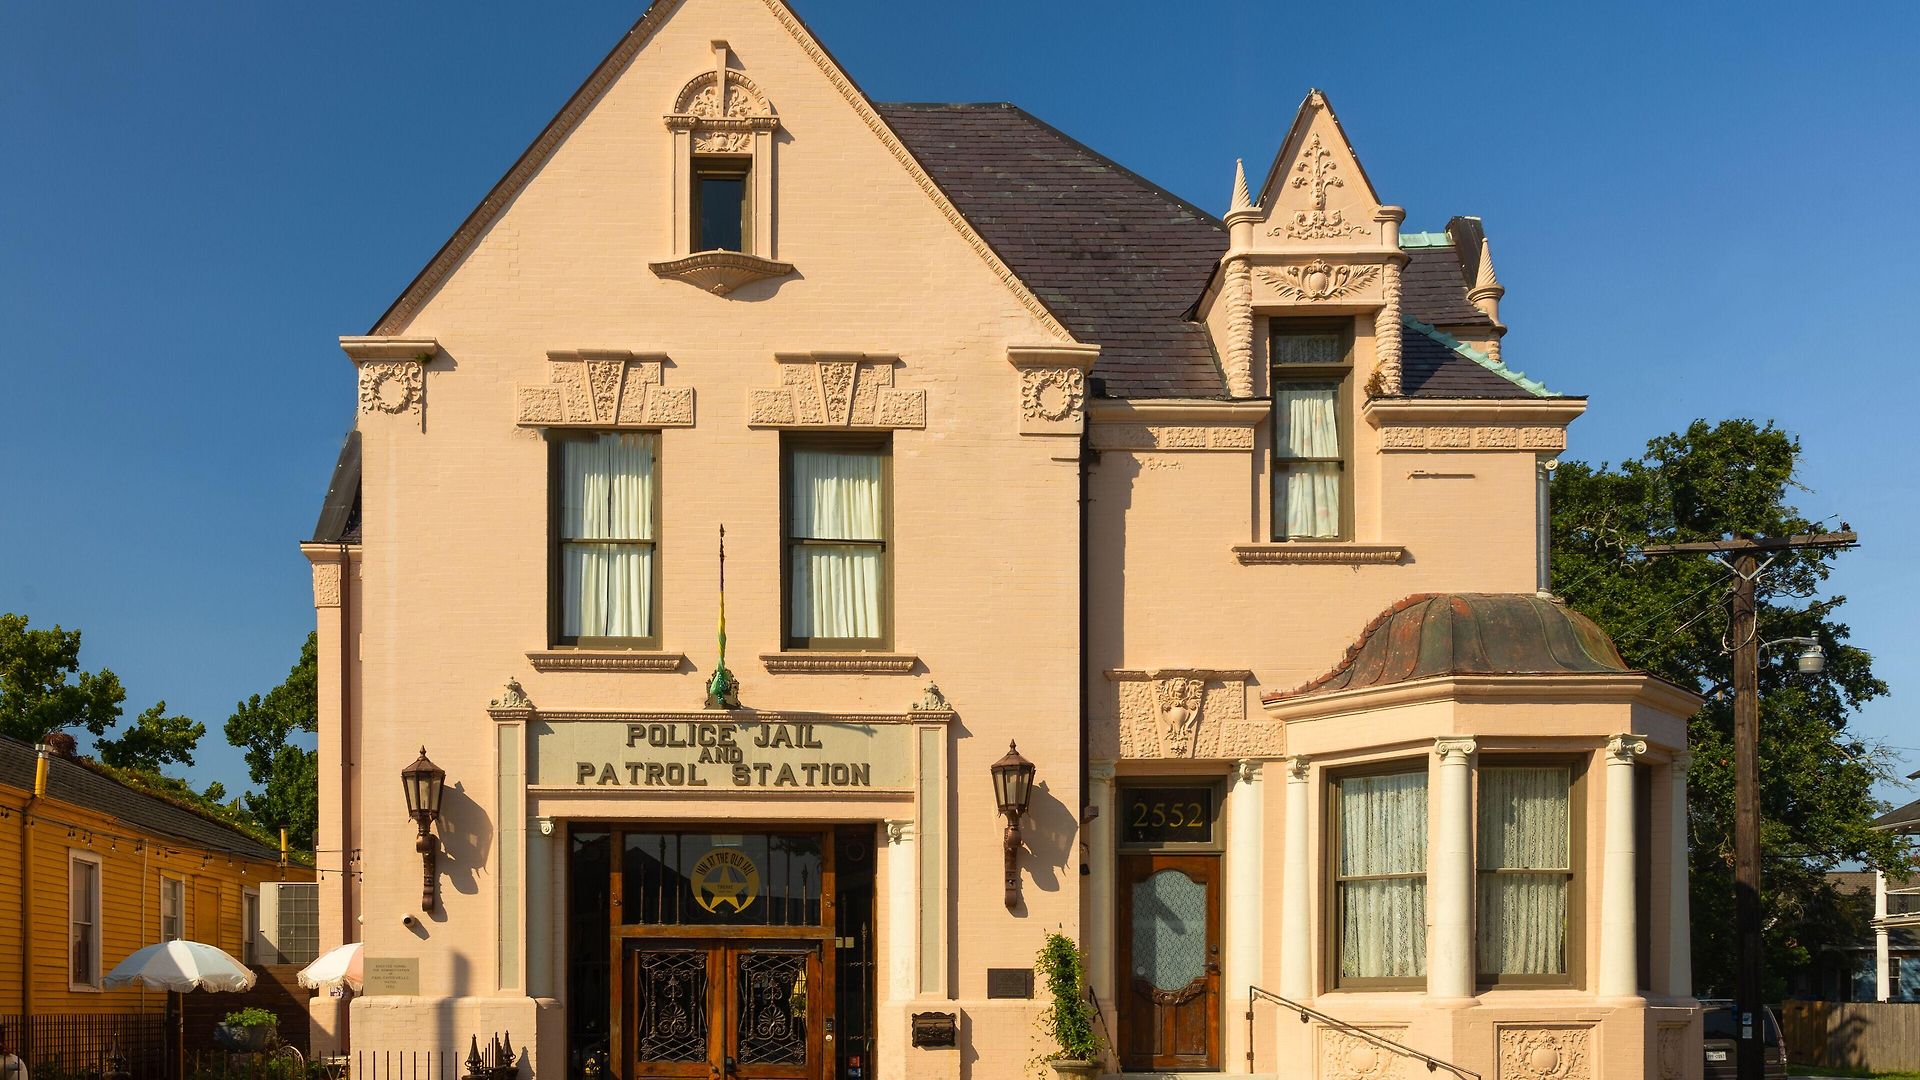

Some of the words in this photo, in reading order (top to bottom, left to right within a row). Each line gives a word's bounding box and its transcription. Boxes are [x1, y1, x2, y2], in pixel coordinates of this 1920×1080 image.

[626, 724, 737, 747] POLICE
[754, 724, 823, 749] JAIL
[698, 747, 743, 764] AND
[576, 762, 708, 786] PATROL
[732, 763, 871, 787] STATION
[1133, 802, 1203, 828] 2552
[696, 862, 711, 876] INN
[707, 855, 716, 868] AT
[715, 852, 729, 864] THE
[731, 853, 745, 867] OLD
[740, 861, 756, 876] JAIL
